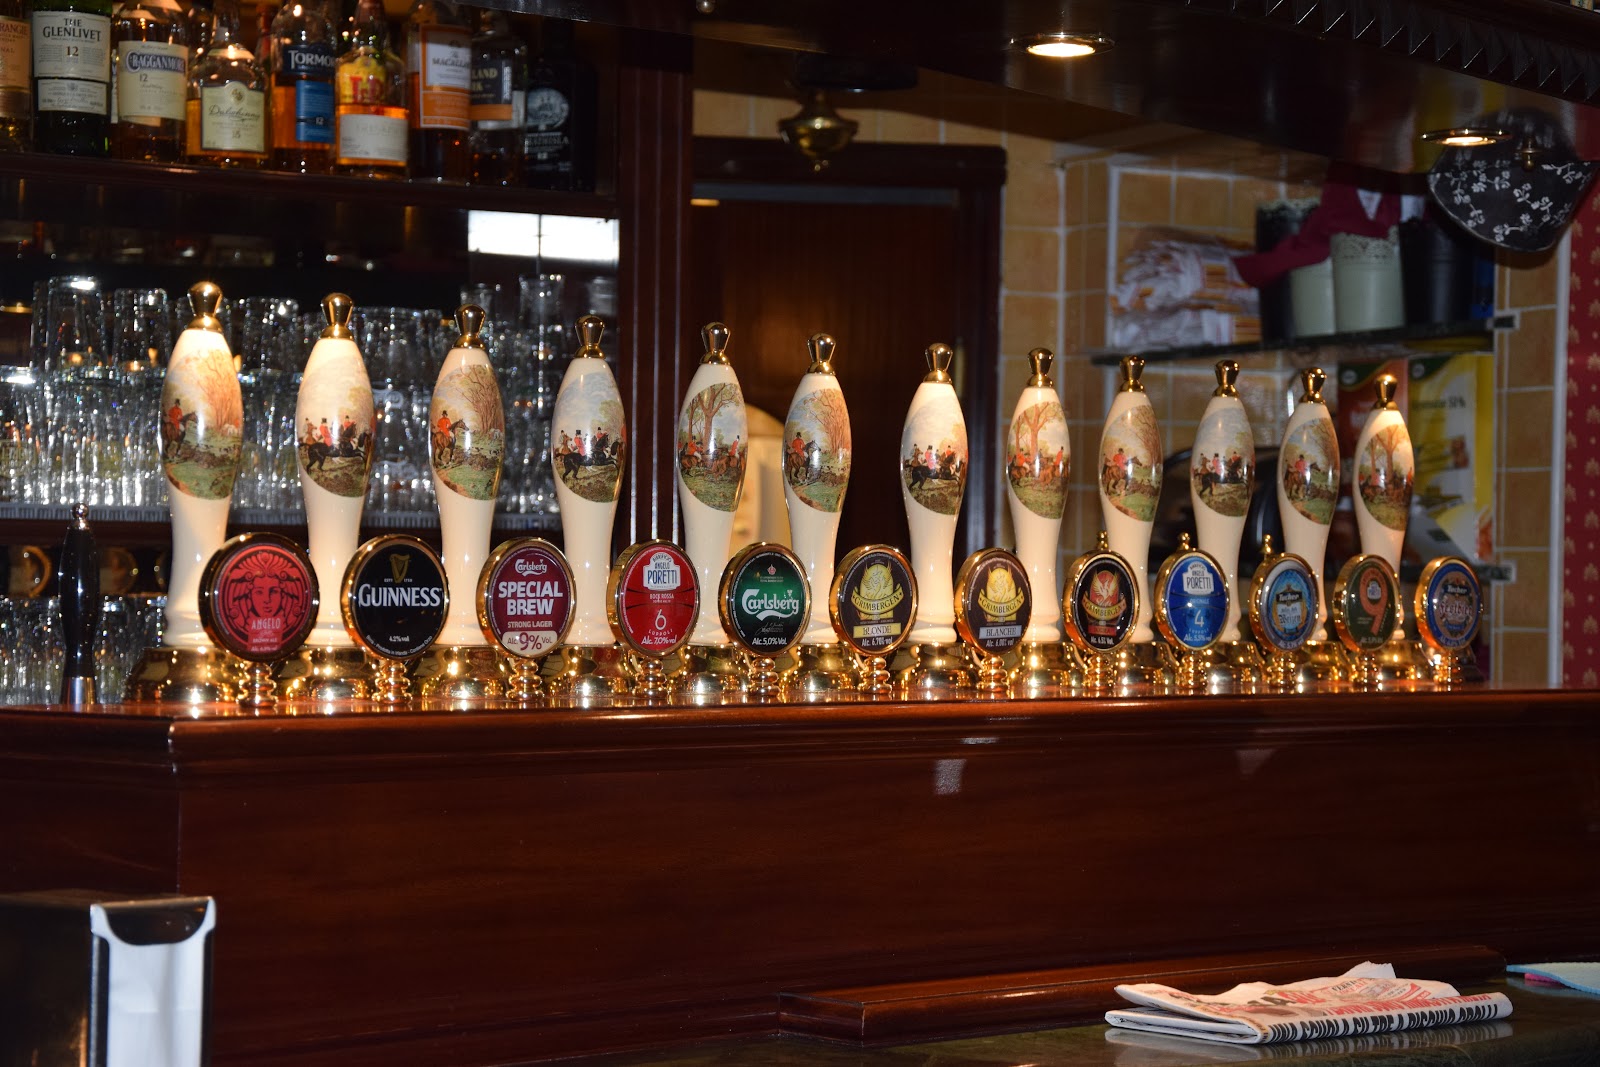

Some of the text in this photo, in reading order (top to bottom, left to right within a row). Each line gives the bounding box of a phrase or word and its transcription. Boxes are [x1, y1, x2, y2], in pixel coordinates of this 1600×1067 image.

[0, 22, 28, 36] RANGIE
[64, 17, 82, 27] THE
[42, 25, 102, 42] GLENLIVET
[66, 45, 79, 56] 12
[126, 51, 185, 73] CRAGGANMORE
[139, 74, 148, 82] 12
[515, 559, 547, 576] Carlsberg
[647, 570, 677, 584] PORETTI
[1186, 576, 1211, 590] PORETTI
[359, 583, 441, 607] GUINNESS
[498, 581, 563, 598] SPECIAL
[507, 599, 554, 616] BREW
[741, 588, 799, 617] Carlsberg
[854, 594, 900, 611] GRIMBERGEN
[981, 599, 1021, 614] GRIMBERGEN
[1084, 601, 1122, 617] GRIMBERGEN
[252, 617, 281, 629] ANGELO
[532, 620, 553, 628] LAGER
[655, 609, 667, 630] 6
[1194, 609, 1205, 628] 4
[862, 625, 892, 636] BLONDE
[986, 627, 1017, 637] BLANCHE
[519, 632, 542, 651] 9%
